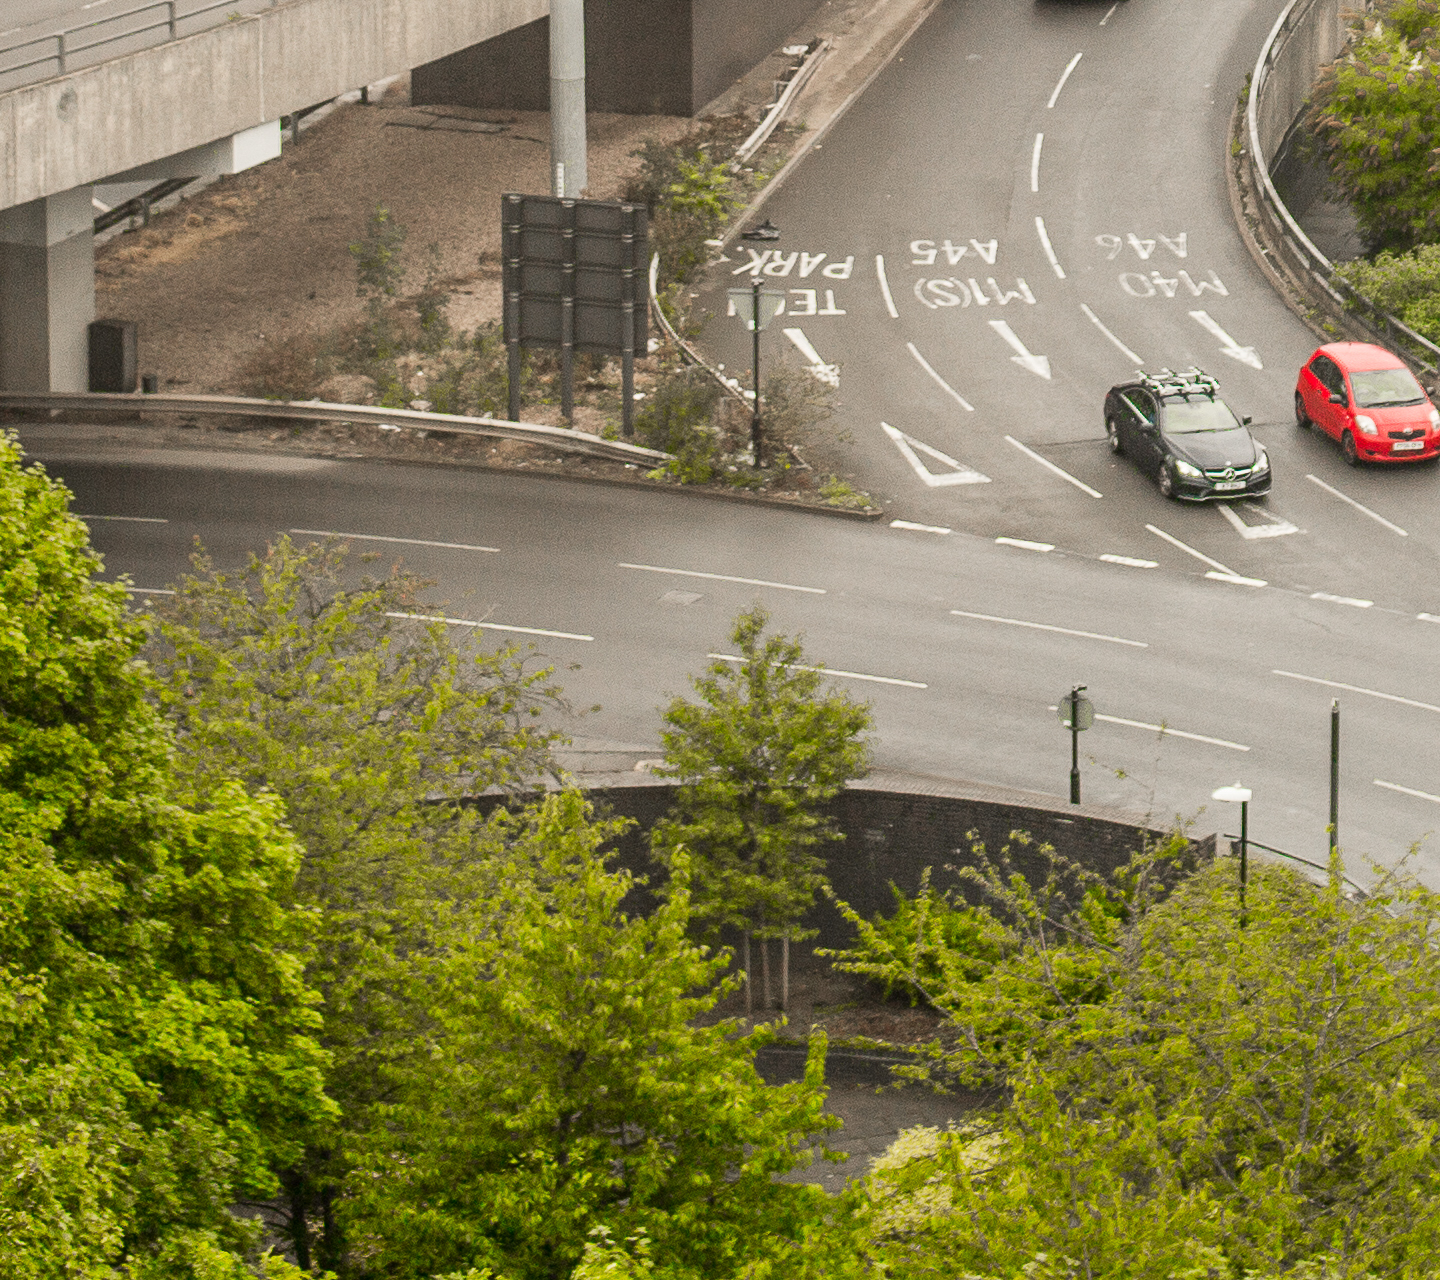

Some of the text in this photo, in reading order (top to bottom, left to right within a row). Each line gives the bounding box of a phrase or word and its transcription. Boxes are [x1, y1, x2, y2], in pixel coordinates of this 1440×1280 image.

[910, 239, 998, 265] A45
[1095, 233, 1188, 259] A46
[914, 277, 1036, 308] M1(S)
[1119, 271, 1229, 299] M40
